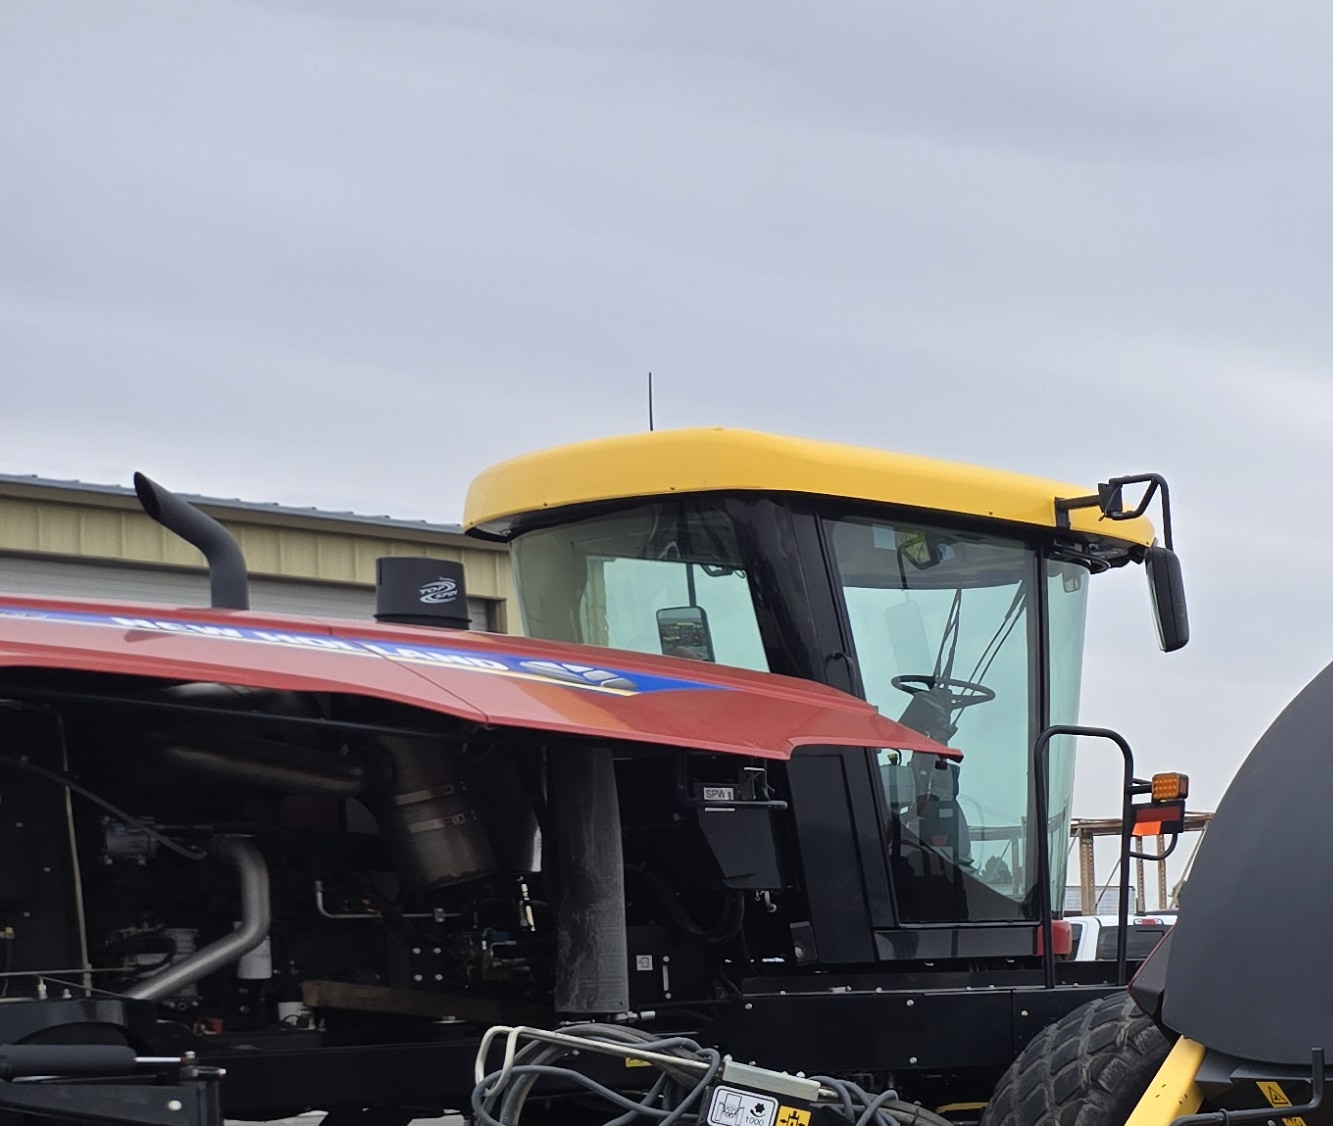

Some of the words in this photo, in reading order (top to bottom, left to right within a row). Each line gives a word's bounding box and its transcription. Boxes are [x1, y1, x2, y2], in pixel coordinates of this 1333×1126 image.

[110, 616, 244, 638] NEW
[253, 631, 510, 671] HOLLAND
[745, 1115, 765, 1126] 1000
